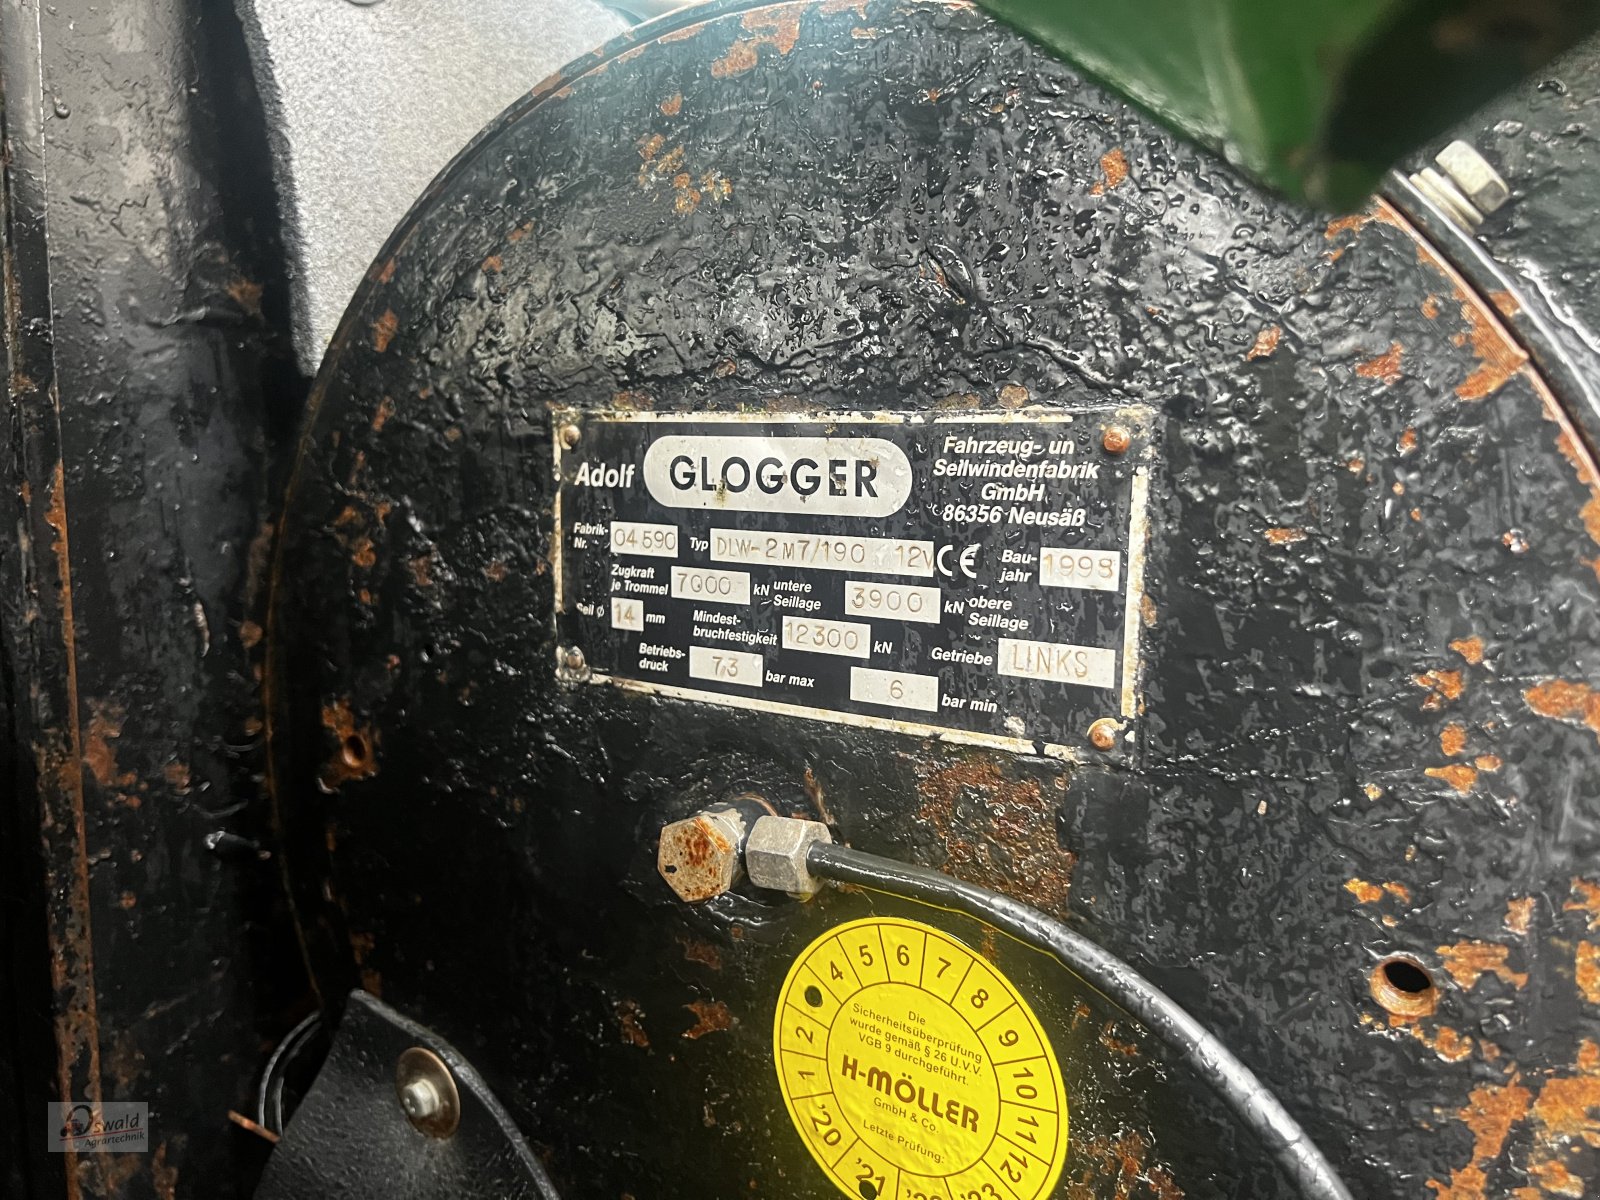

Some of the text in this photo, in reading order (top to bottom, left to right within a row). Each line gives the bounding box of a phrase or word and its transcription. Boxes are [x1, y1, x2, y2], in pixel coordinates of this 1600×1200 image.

[943, 436, 1042, 457] Fahrzeug-
[575, 462, 635, 488] Adolf
[670, 455, 878, 498] GLOGGER
[981, 482, 1045, 502] GmbH
[942, 504, 1086, 526] 86356 Neusäß
[573, 522, 609, 536] Fabrik-
[574, 537, 588, 549] Nr.
[690, 537, 709, 551] Typ
[1001, 549, 1038, 564] Bau-
[1042, 553, 1113, 579] 1998
[611, 563, 655, 579] Zugkraft
[999, 567, 1033, 583] jahr
[611, 579, 668, 595] je Trommel
[677, 573, 732, 595] 7000
[753, 584, 770, 597] kN
[773, 580, 812, 593] untere
[773, 594, 822, 611] Seillage
[851, 587, 923, 613] 3900
[943, 600, 965, 615] kN
[968, 596, 1013, 611] obere
[614, 603, 636, 626] 14
[646, 613, 666, 624] mm
[692, 610, 741, 625] Mindest-
[968, 612, 1029, 632] Seillage
[692, 625, 778, 646] bruchfestigkeit
[785, 622, 858, 650] 12300
[638, 642, 686, 658] Betriebs-
[873, 640, 893, 654] kN
[931, 647, 993, 666] Getriebe
[638, 658, 669, 672] druck
[1011, 643, 1089, 678] LINKS
[765, 669, 815, 688] bar max
[889, 679, 904, 700] 6
[941, 693, 998, 713] bar min
[859, 944, 874, 967] 5
[896, 944, 910, 967] 6
[829, 960, 844, 982] 4
[936, 957, 952, 979] 7
[970, 988, 989, 1009] 8
[908, 1010, 926, 1026] Die
[795, 1026, 814, 1044] 2
[850, 1017, 882, 1036] wurde
[885, 1031, 921, 1052] gemäß
[924, 1045, 931, 1058] §
[934, 1049, 947, 1062] 26
[852, 1003, 982, 1064] Sicherheitsüberprüfung
[998, 1029, 1019, 1047] 9
[858, 1032, 969, 1086] VGB 9 durchgeführt.
[798, 1069, 815, 1080] 1
[1013, 1066, 1038, 1099] 10
[841, 1054, 980, 1133] H-MÖLLER
[873, 1097, 940, 1133] GmbH & Co.
[1015, 1115, 1039, 1146] 11
[863, 1120, 945, 1164] Letzte Prüfung:
[1000, 1151, 1028, 1183] 12
